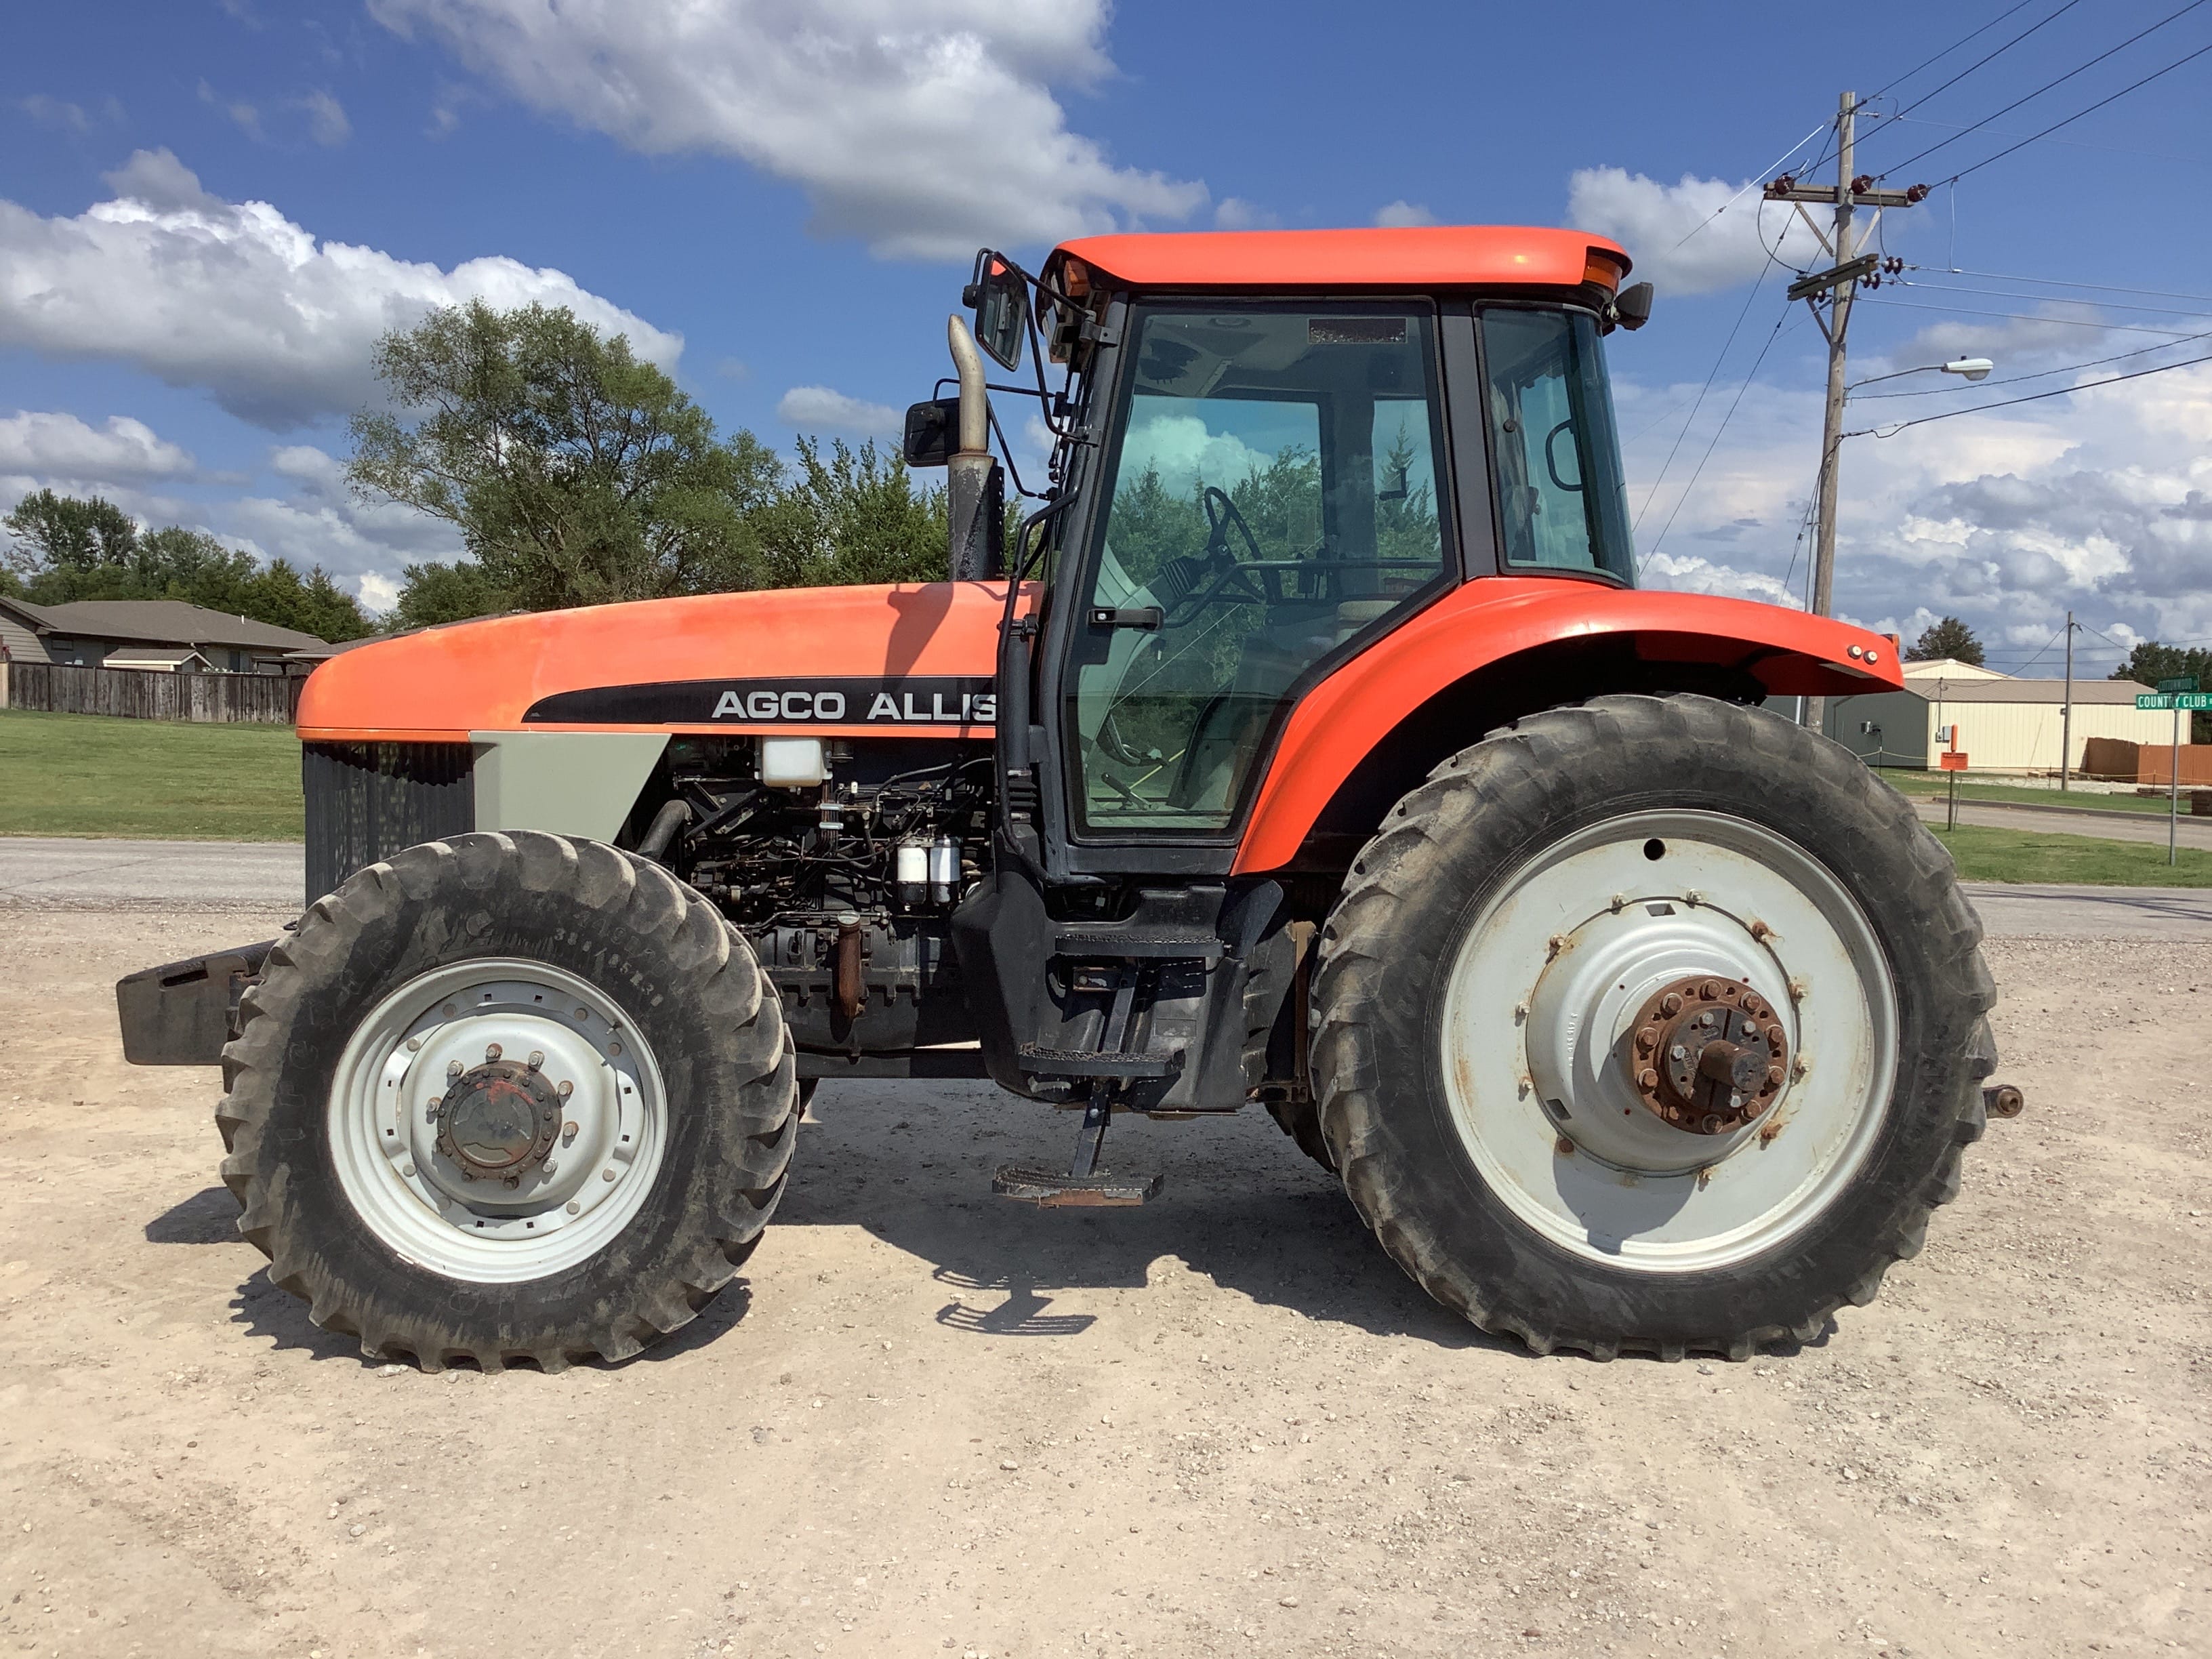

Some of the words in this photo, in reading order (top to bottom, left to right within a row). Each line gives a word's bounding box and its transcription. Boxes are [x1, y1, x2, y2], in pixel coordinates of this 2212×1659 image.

[711, 691, 846, 720] AGCO
[866, 692, 996, 722] ALLIS
[2138, 696, 2180, 708] COUNTRY
[2183, 695, 2207, 708] CLUB
